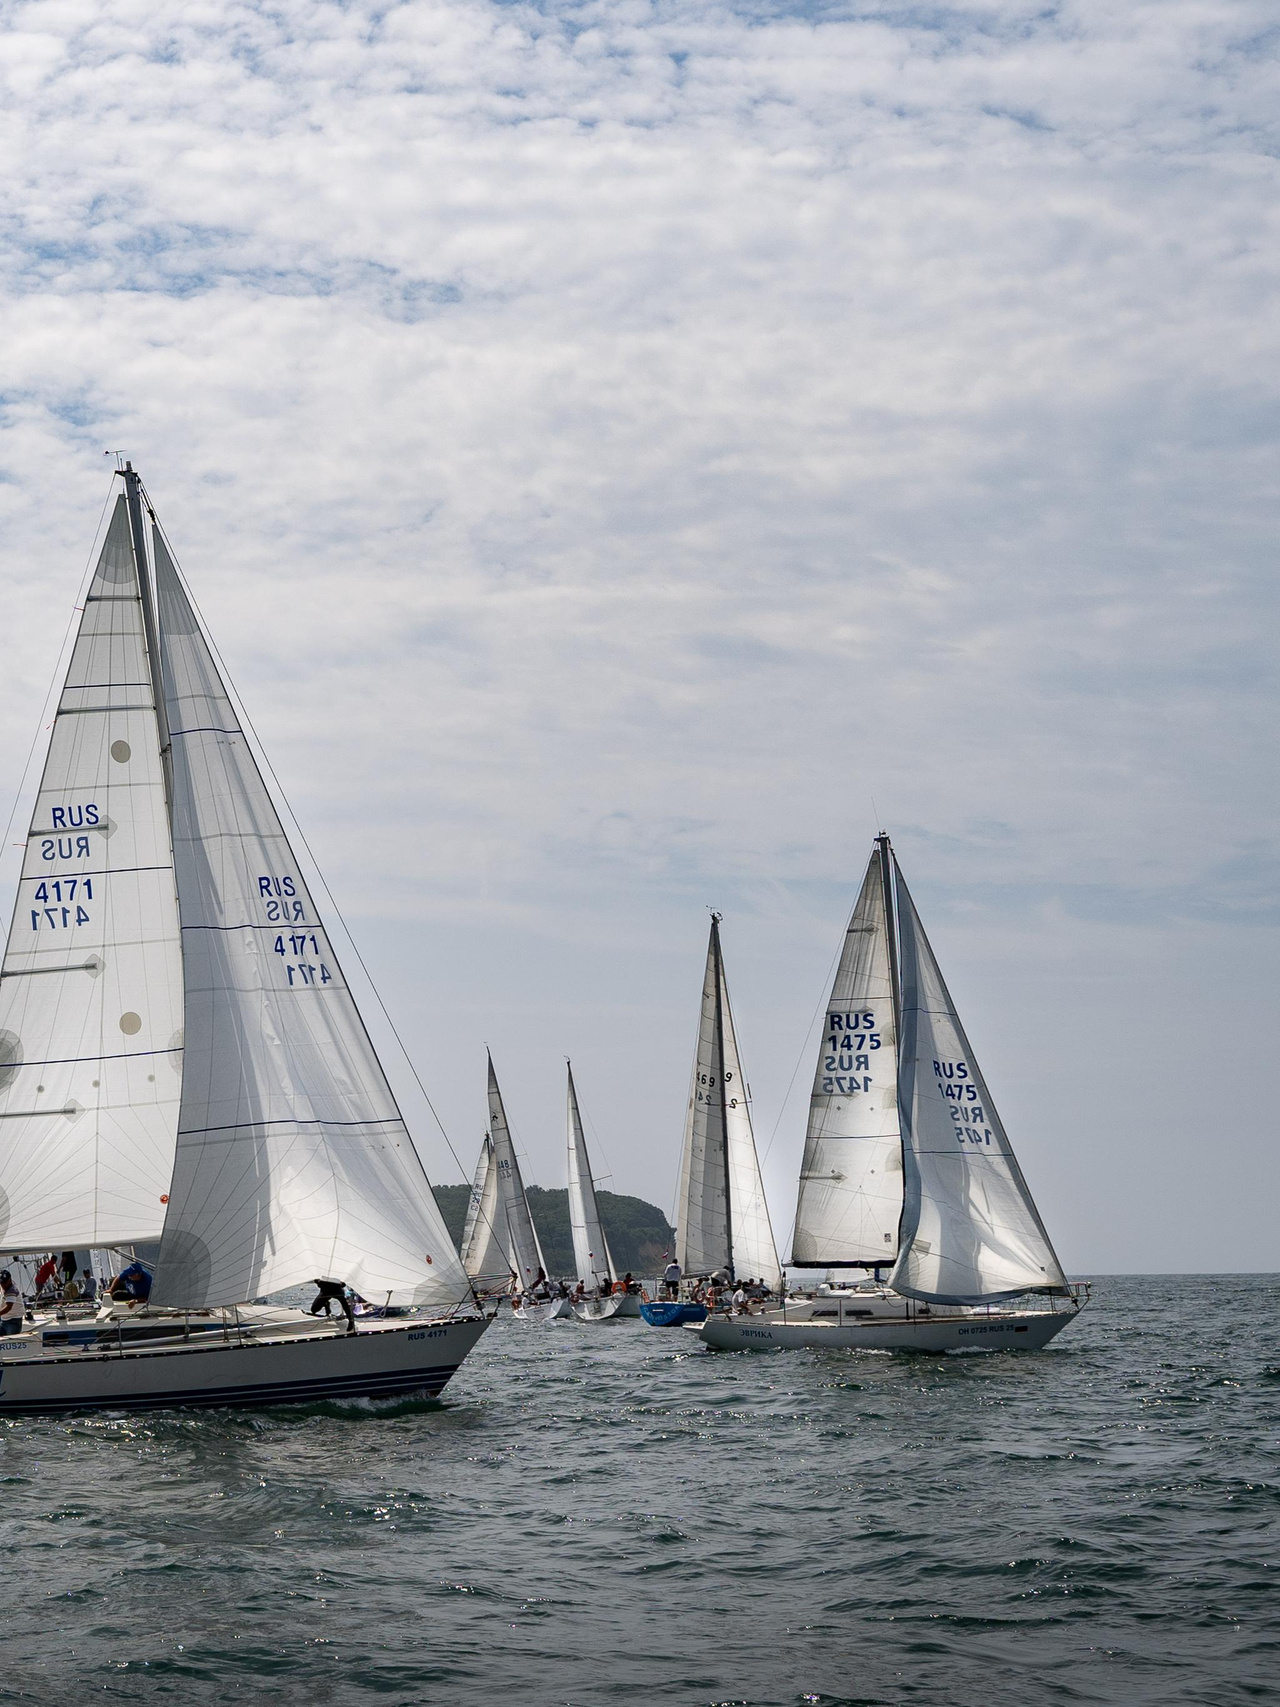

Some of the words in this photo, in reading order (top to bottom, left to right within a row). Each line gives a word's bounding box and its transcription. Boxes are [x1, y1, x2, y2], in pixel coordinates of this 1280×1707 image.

[51, 804, 99, 828] RUS
[34, 879, 93, 904] 4171
[258, 876, 296, 898] RUS
[274, 934, 319, 957] 4171
[830, 1013, 875, 1031] RUS
[827, 1033, 882, 1052] 1475
[932, 1060, 969, 1080] RUS
[937, 1083, 977, 1101] 1475
[408, 1332, 425, 1341] RUS
[427, 1329, 447, 1338] 4171
[740, 1329, 773, 1339] ЭВРИКА
[989, 1324, 1004, 1332] RUS
